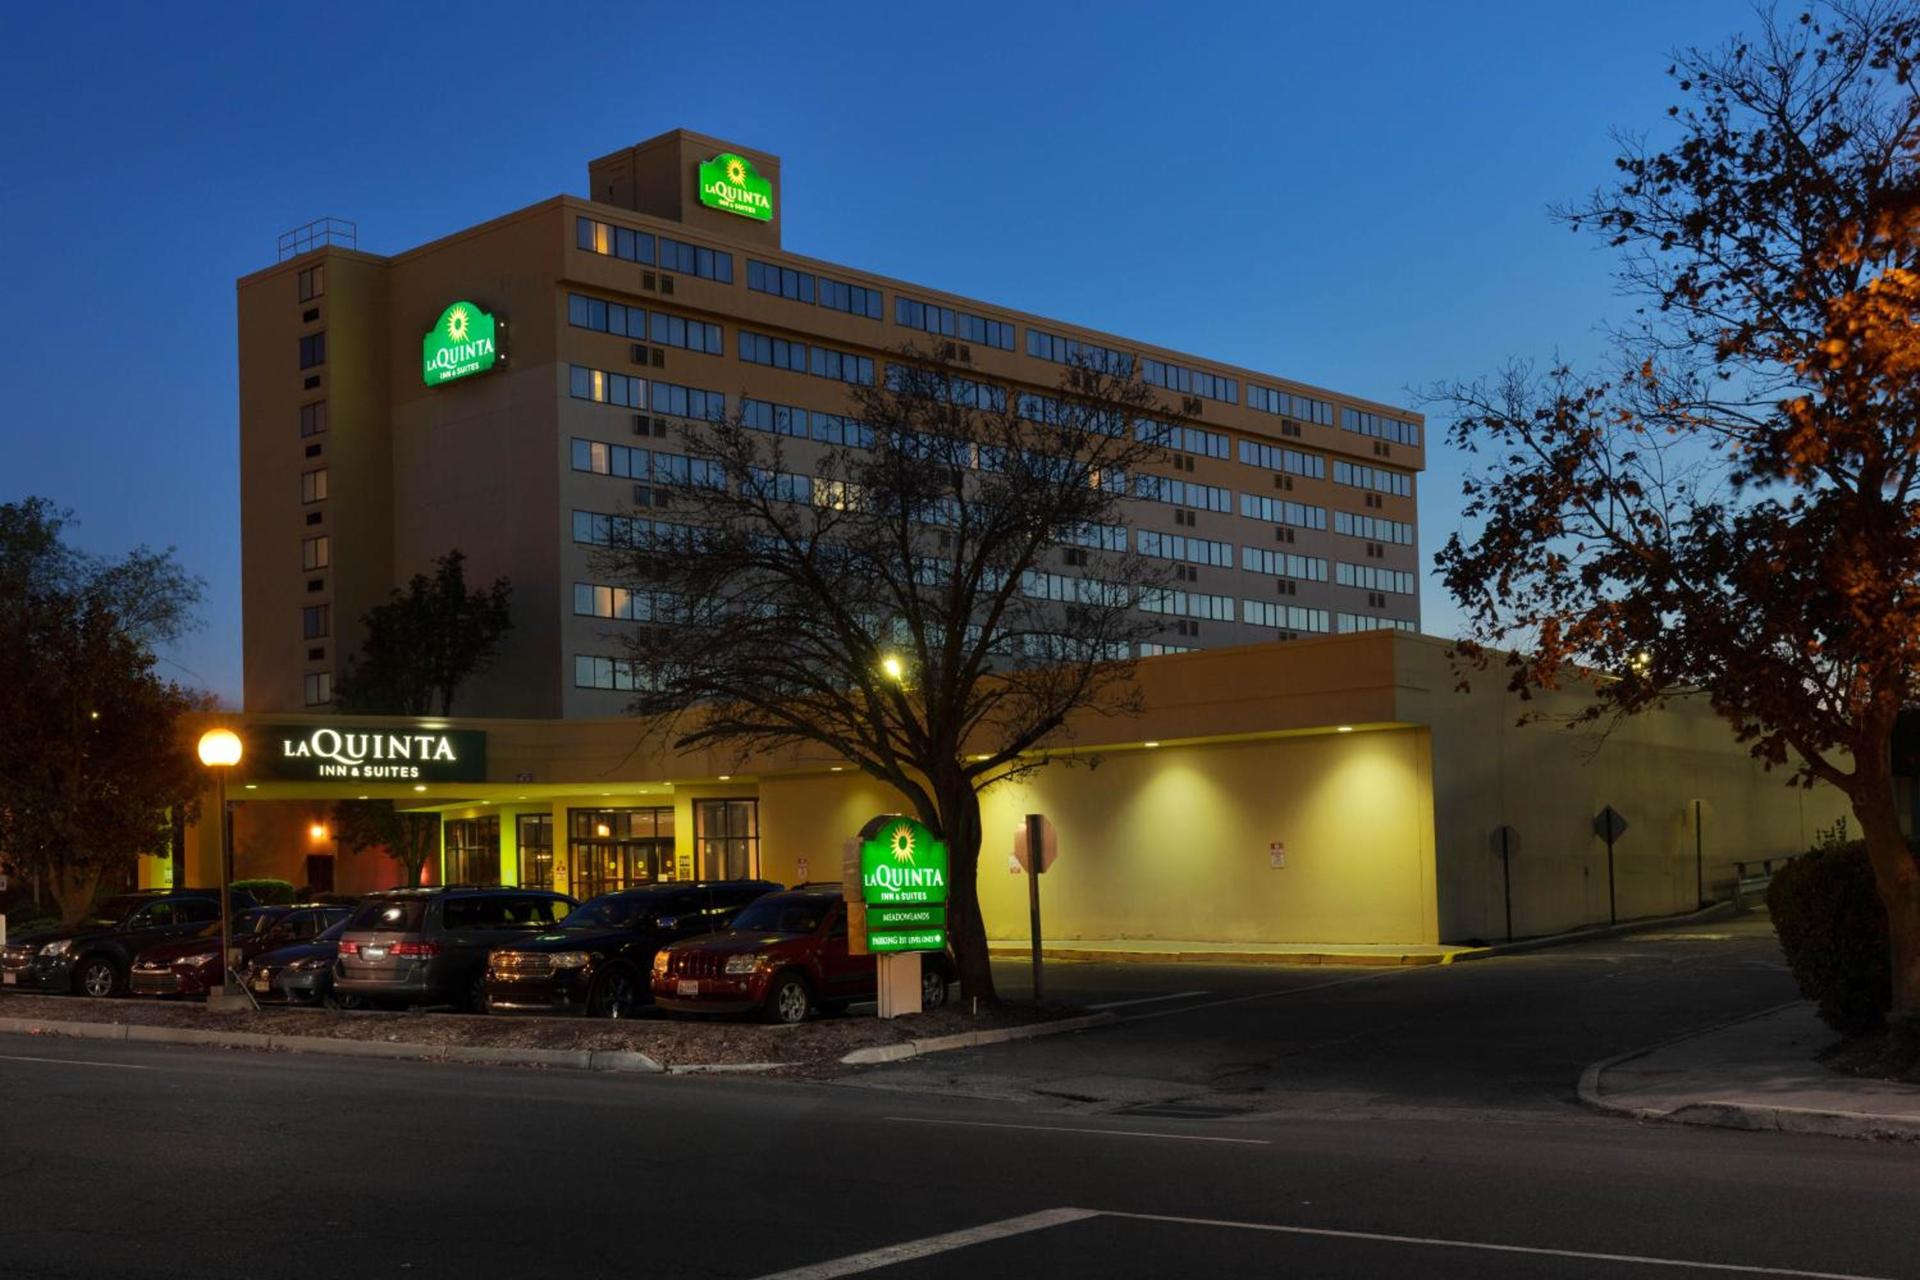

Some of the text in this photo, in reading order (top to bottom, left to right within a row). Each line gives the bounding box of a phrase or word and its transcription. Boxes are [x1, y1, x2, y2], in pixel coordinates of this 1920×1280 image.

[705, 181, 770, 209] LA QUINTA
[735, 203, 756, 213] SUITES
[427, 337, 494, 372] LA QUINTA
[440, 371, 452, 379] INN
[456, 361, 480, 375] SUITES
[283, 728, 456, 765] LA QUINTA
[319, 765, 419, 778] INN & SUITES
[864, 864, 944, 892] LA QUINTA
[881, 892, 927, 901] INN & SUITES
[872, 936, 898, 945] PARKING
